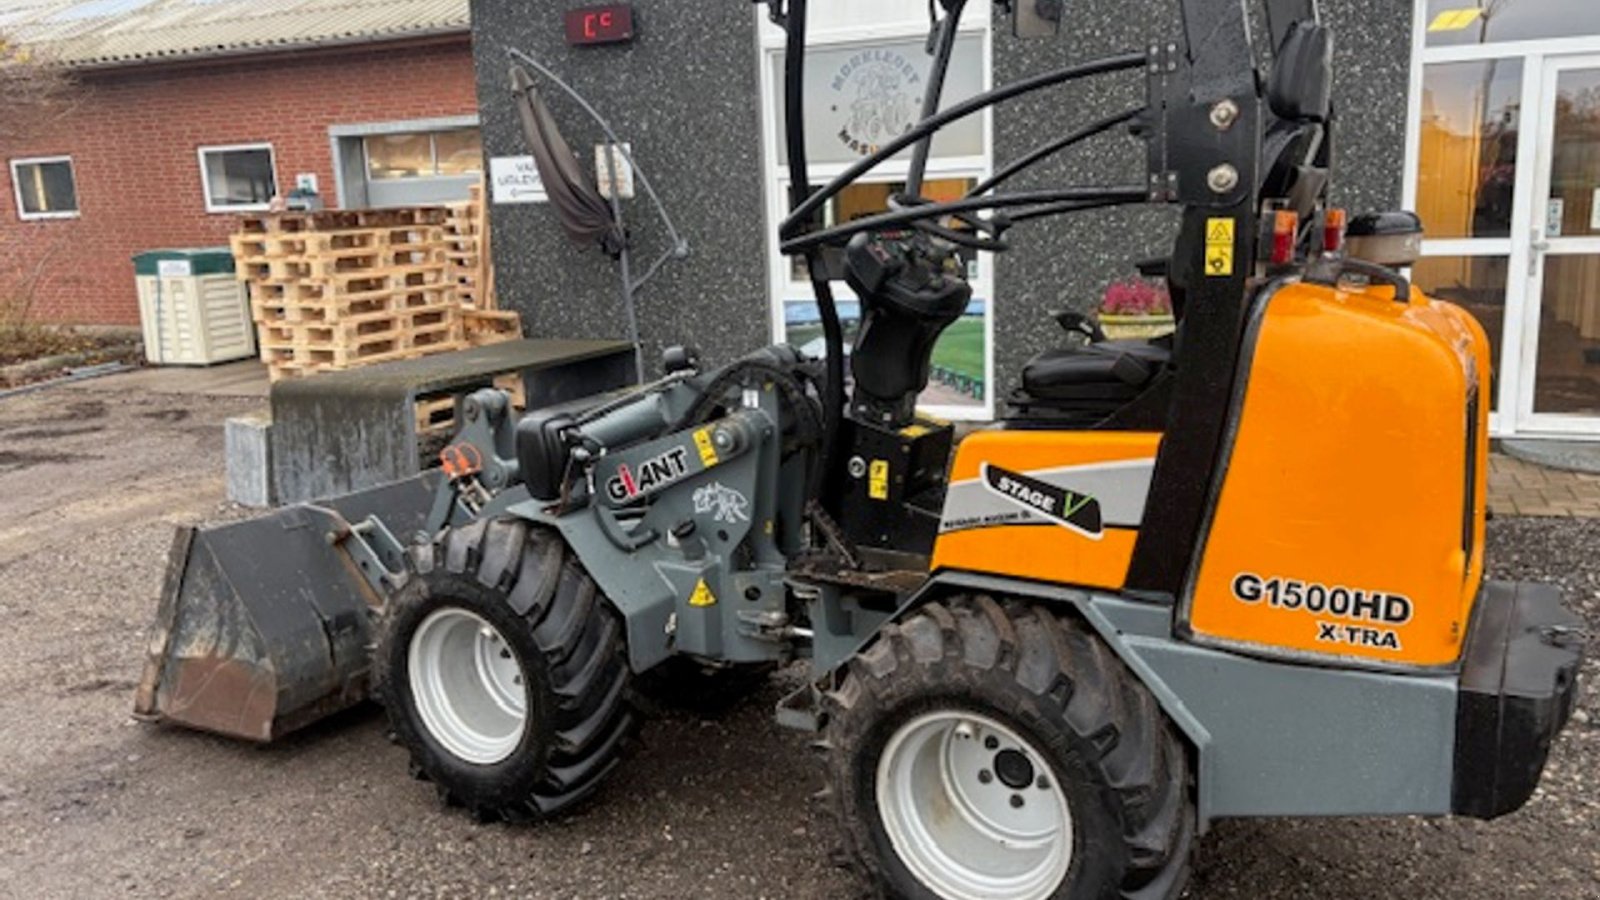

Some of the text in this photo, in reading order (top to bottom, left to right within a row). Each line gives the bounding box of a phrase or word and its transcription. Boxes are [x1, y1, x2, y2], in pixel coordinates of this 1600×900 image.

[997, 476, 1095, 518] STAGE V
[1233, 574, 1411, 623] G1500HD
